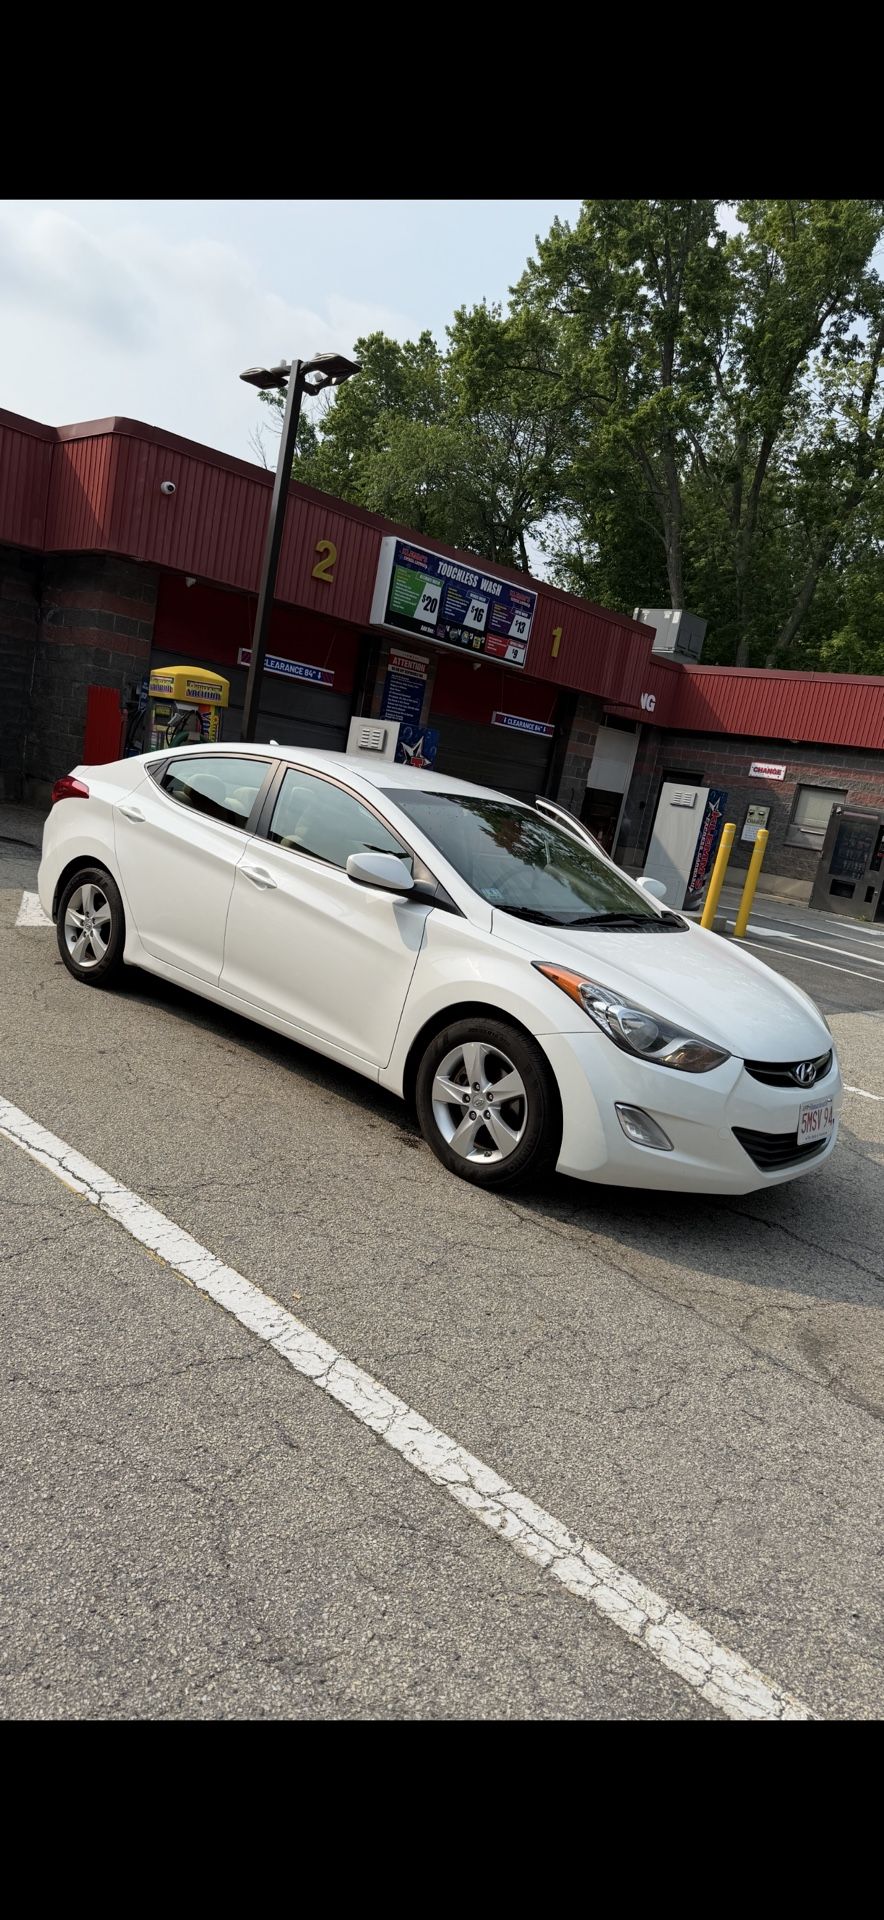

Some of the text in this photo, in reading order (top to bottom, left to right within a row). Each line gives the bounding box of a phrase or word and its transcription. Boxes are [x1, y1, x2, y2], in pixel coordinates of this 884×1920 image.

[311, 540, 338, 583] 2
[437, 561, 479, 588] TOUCHLESS
[480, 577, 502, 597] WASH
[422, 594, 438, 614] $20
[471, 606, 485, 622] $16
[515, 620, 527, 634] $13
[551, 626, 563, 658] 1
[512, 649, 519, 659] $9
[392, 656, 426, 673] ATTENTION
[507, 718, 535, 731] CLEARANCE
[753, 767, 782, 775] CHANGE
[801, 1109, 823, 1134] 5MSV
